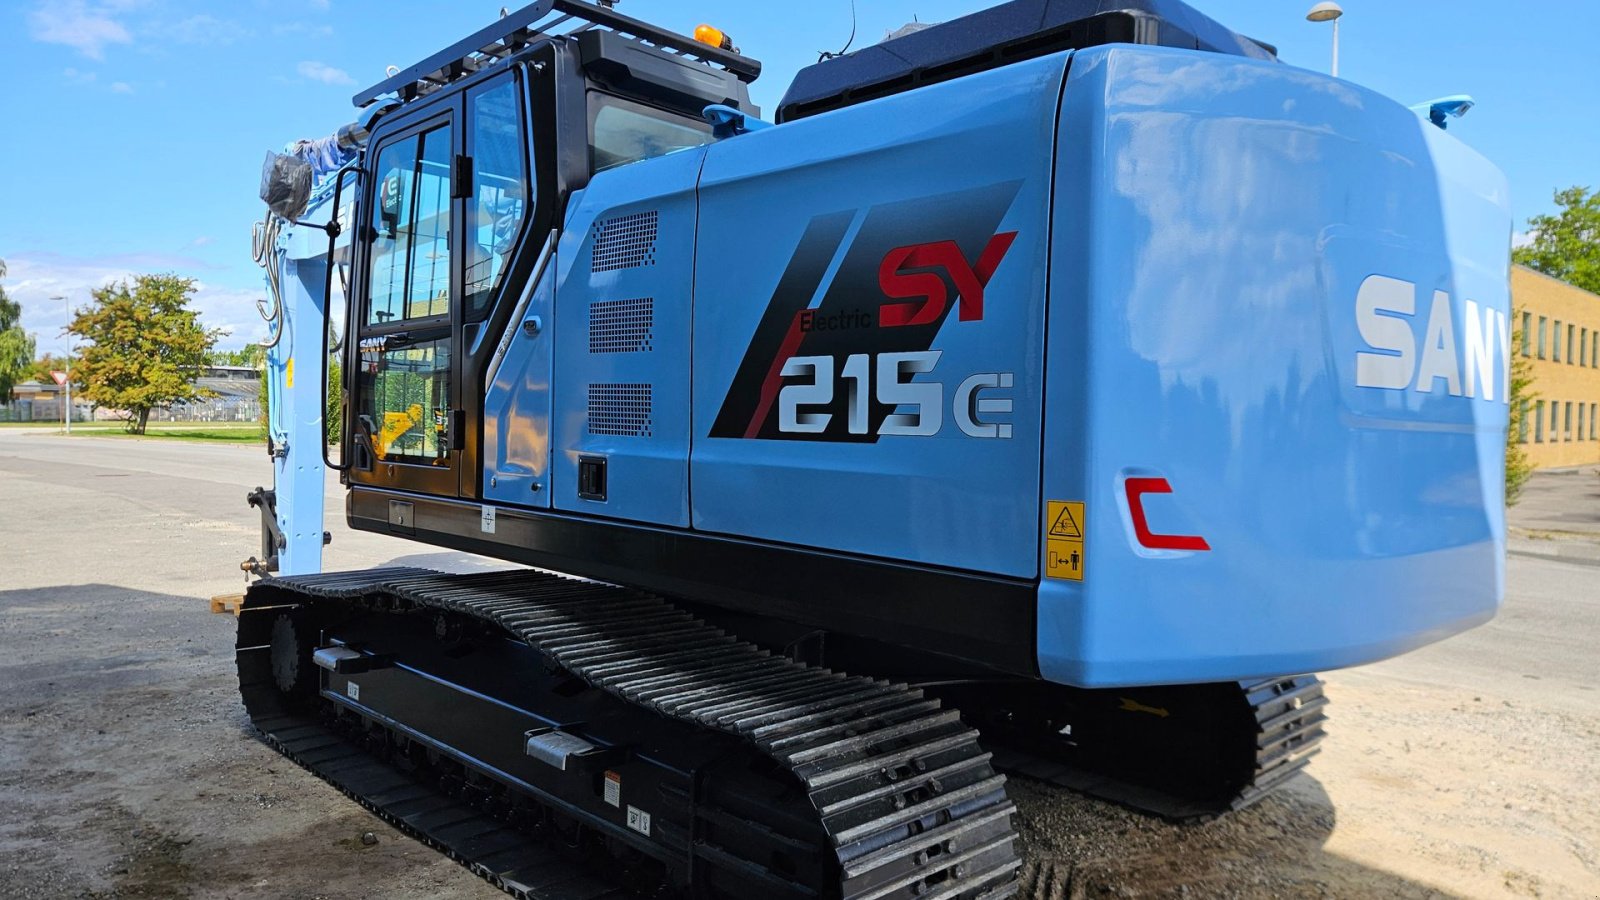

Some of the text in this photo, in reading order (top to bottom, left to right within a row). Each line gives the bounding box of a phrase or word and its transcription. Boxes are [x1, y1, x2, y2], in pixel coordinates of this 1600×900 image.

[800, 310, 872, 333] Electric
[878, 231, 1018, 327] SY
[1355, 275, 1511, 404] SANY
[779, 350, 944, 437] 215
